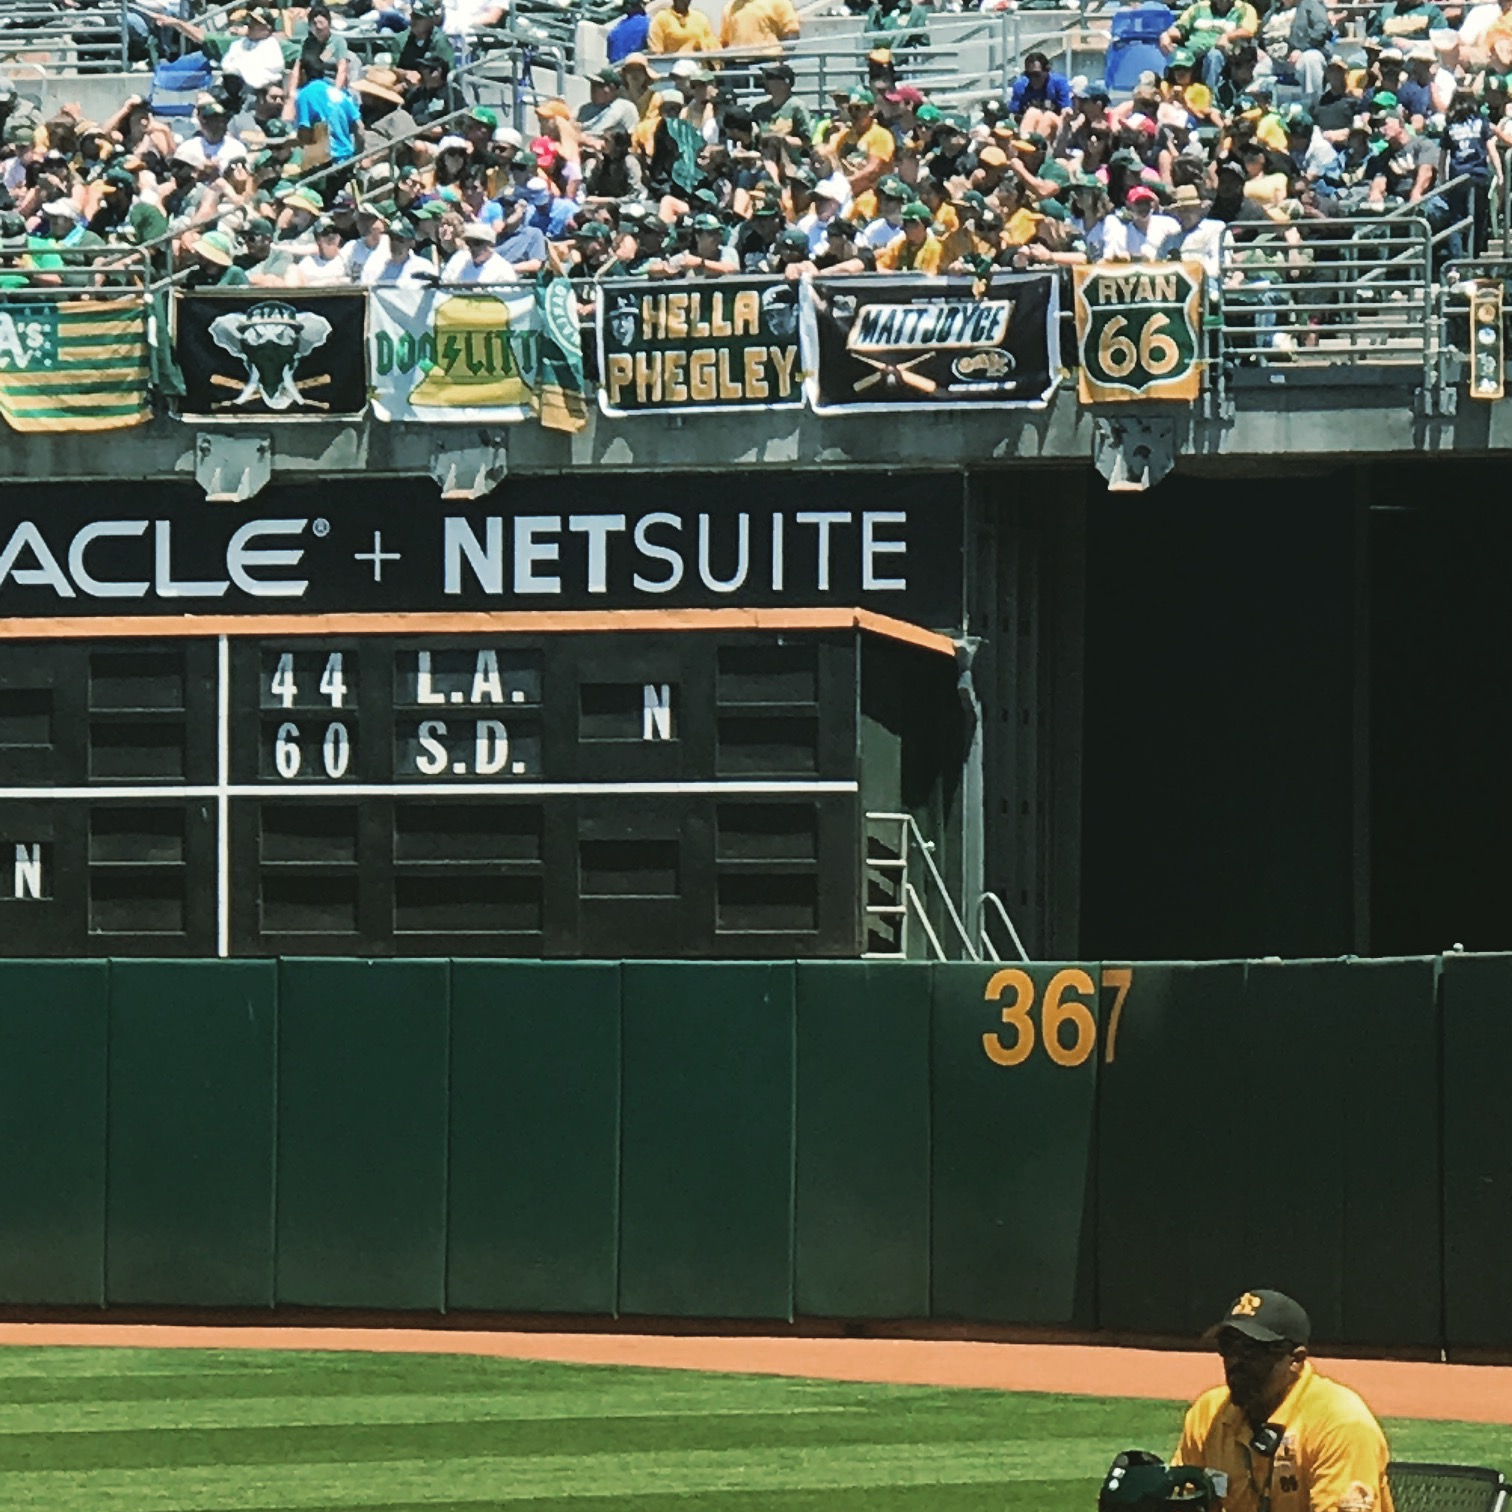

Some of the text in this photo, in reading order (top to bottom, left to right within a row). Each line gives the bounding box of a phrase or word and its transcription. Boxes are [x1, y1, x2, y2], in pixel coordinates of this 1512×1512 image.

[642, 291, 760, 340] HELLA
[1098, 275, 1177, 304] RYAN
[859, 304, 1005, 344] MATT JOYCE
[1098, 311, 1180, 378] 66
[608, 345, 798, 404] PHEGLEY
[444, 512, 907, 594] NETSUITE
[416, 649, 526, 704] L.A.
[643, 684, 671, 740] N
[416, 720, 526, 775] S.D.
[14, 843, 41, 900] N
[982, 968, 1132, 1067] 367
